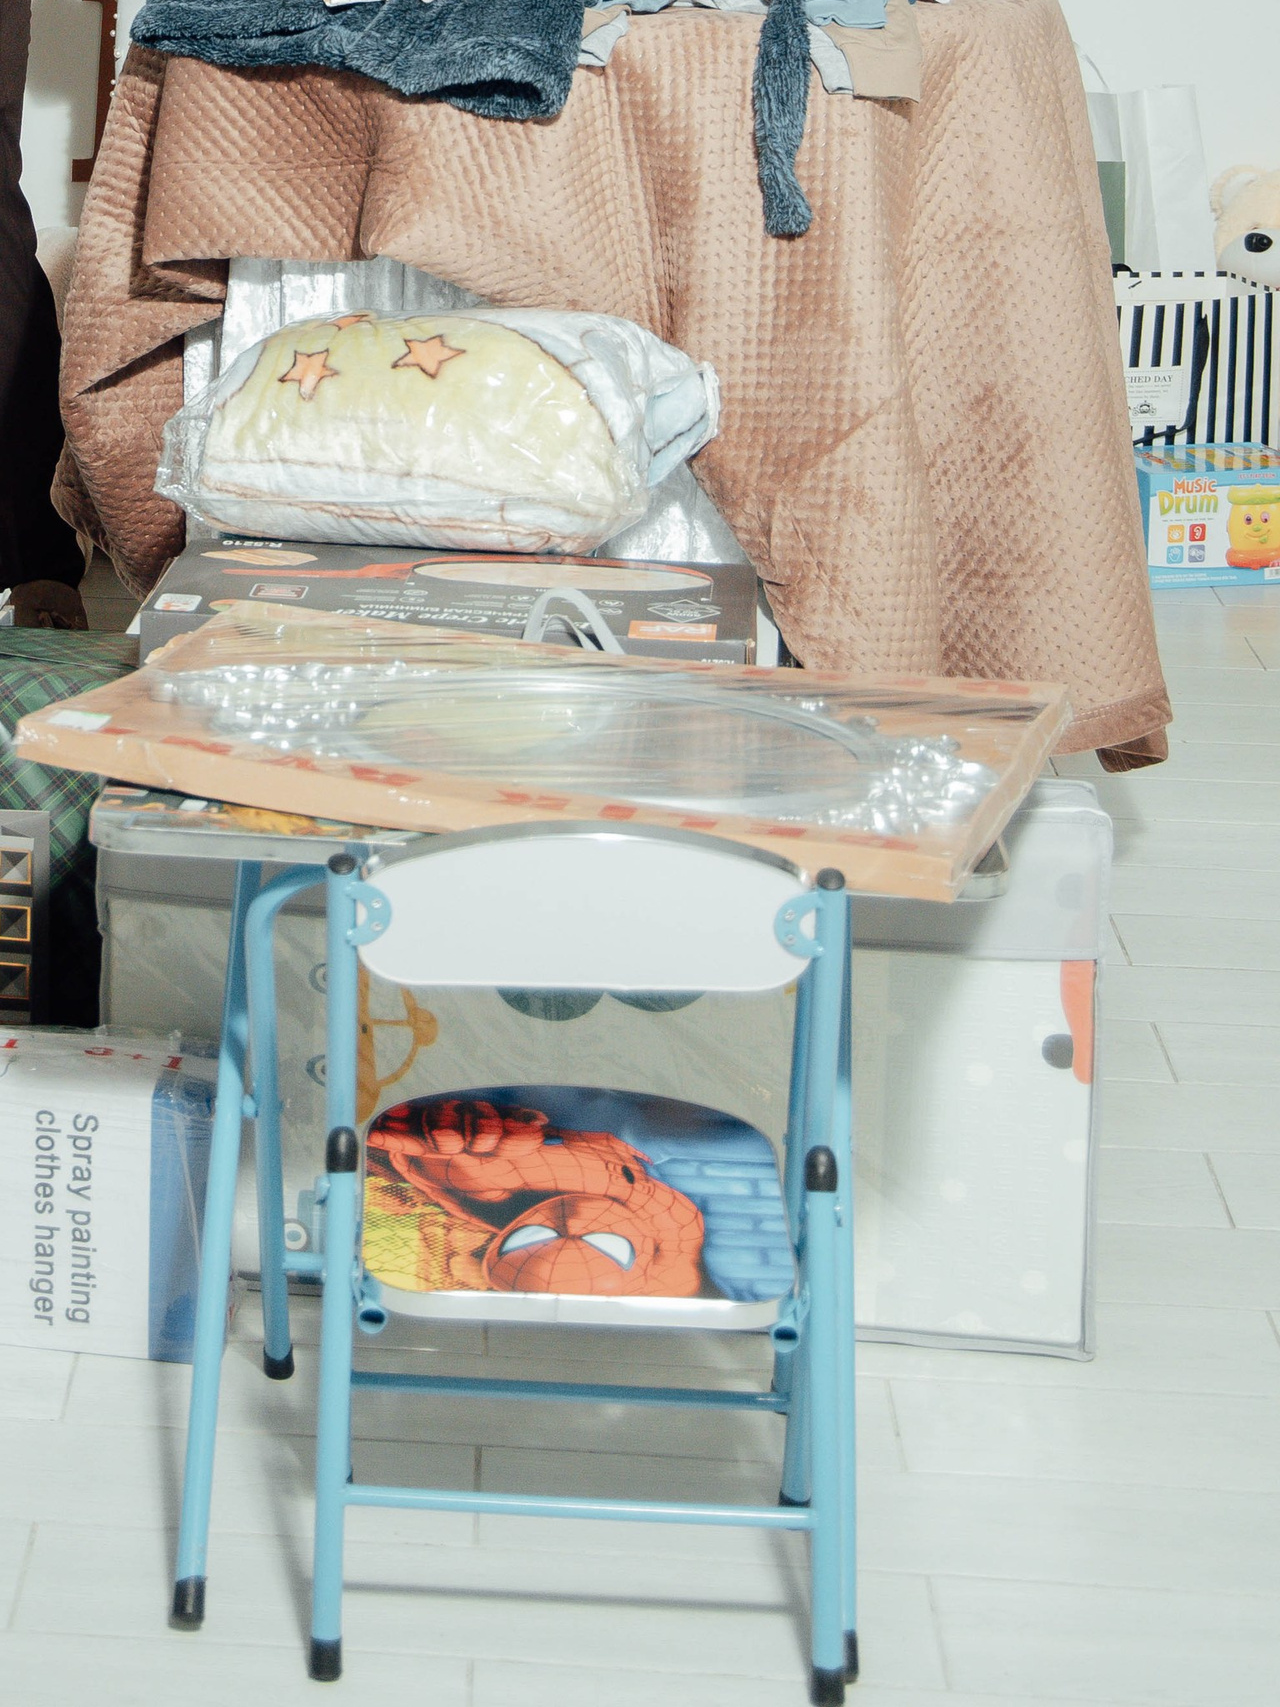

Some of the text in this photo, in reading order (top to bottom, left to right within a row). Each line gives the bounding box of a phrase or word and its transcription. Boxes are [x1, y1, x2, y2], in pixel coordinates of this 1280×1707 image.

[1154, 375, 1173, 383] DAY
[1158, 491, 1219, 516] Drum
[328, 607, 408, 620] Maker
[417, 611, 488, 624] Crepe
[637, 624, 707, 635] RAF
[83, 1046, 185, 1070] 3+1
[29, 1109, 61, 1326] clothes hanger
[65, 1113, 99, 1324] Spray painting
